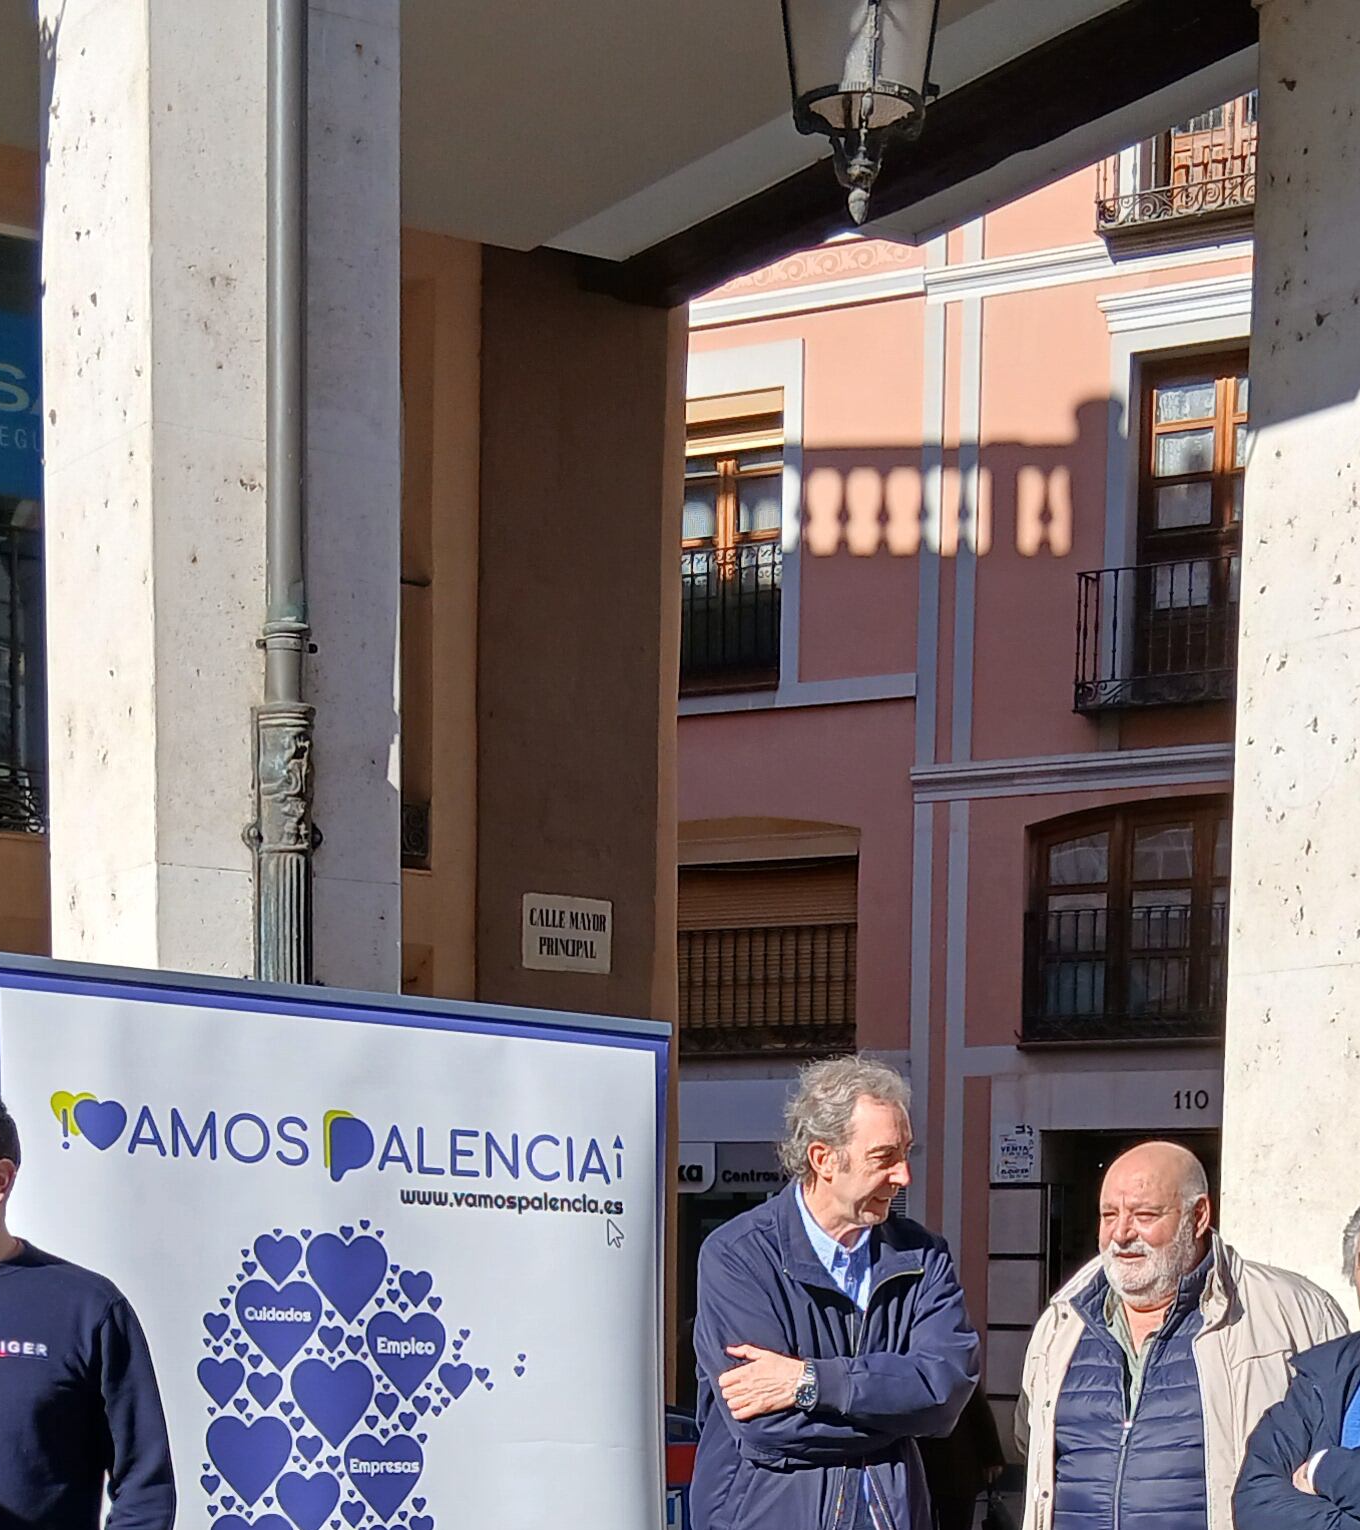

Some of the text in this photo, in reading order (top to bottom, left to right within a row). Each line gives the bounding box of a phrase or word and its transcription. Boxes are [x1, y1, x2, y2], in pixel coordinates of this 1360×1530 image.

[529, 907, 607, 933] CALLE MAYOR
[539, 936, 597, 959] PRINCIPAL
[1173, 1089, 1209, 1110] 110
[400, 1186, 624, 1216] www.vamospalencia.es
[244, 1306, 312, 1323] Cuidados
[376, 1337, 436, 1359] Empleo
[349, 1458, 420, 1477] Empresas
